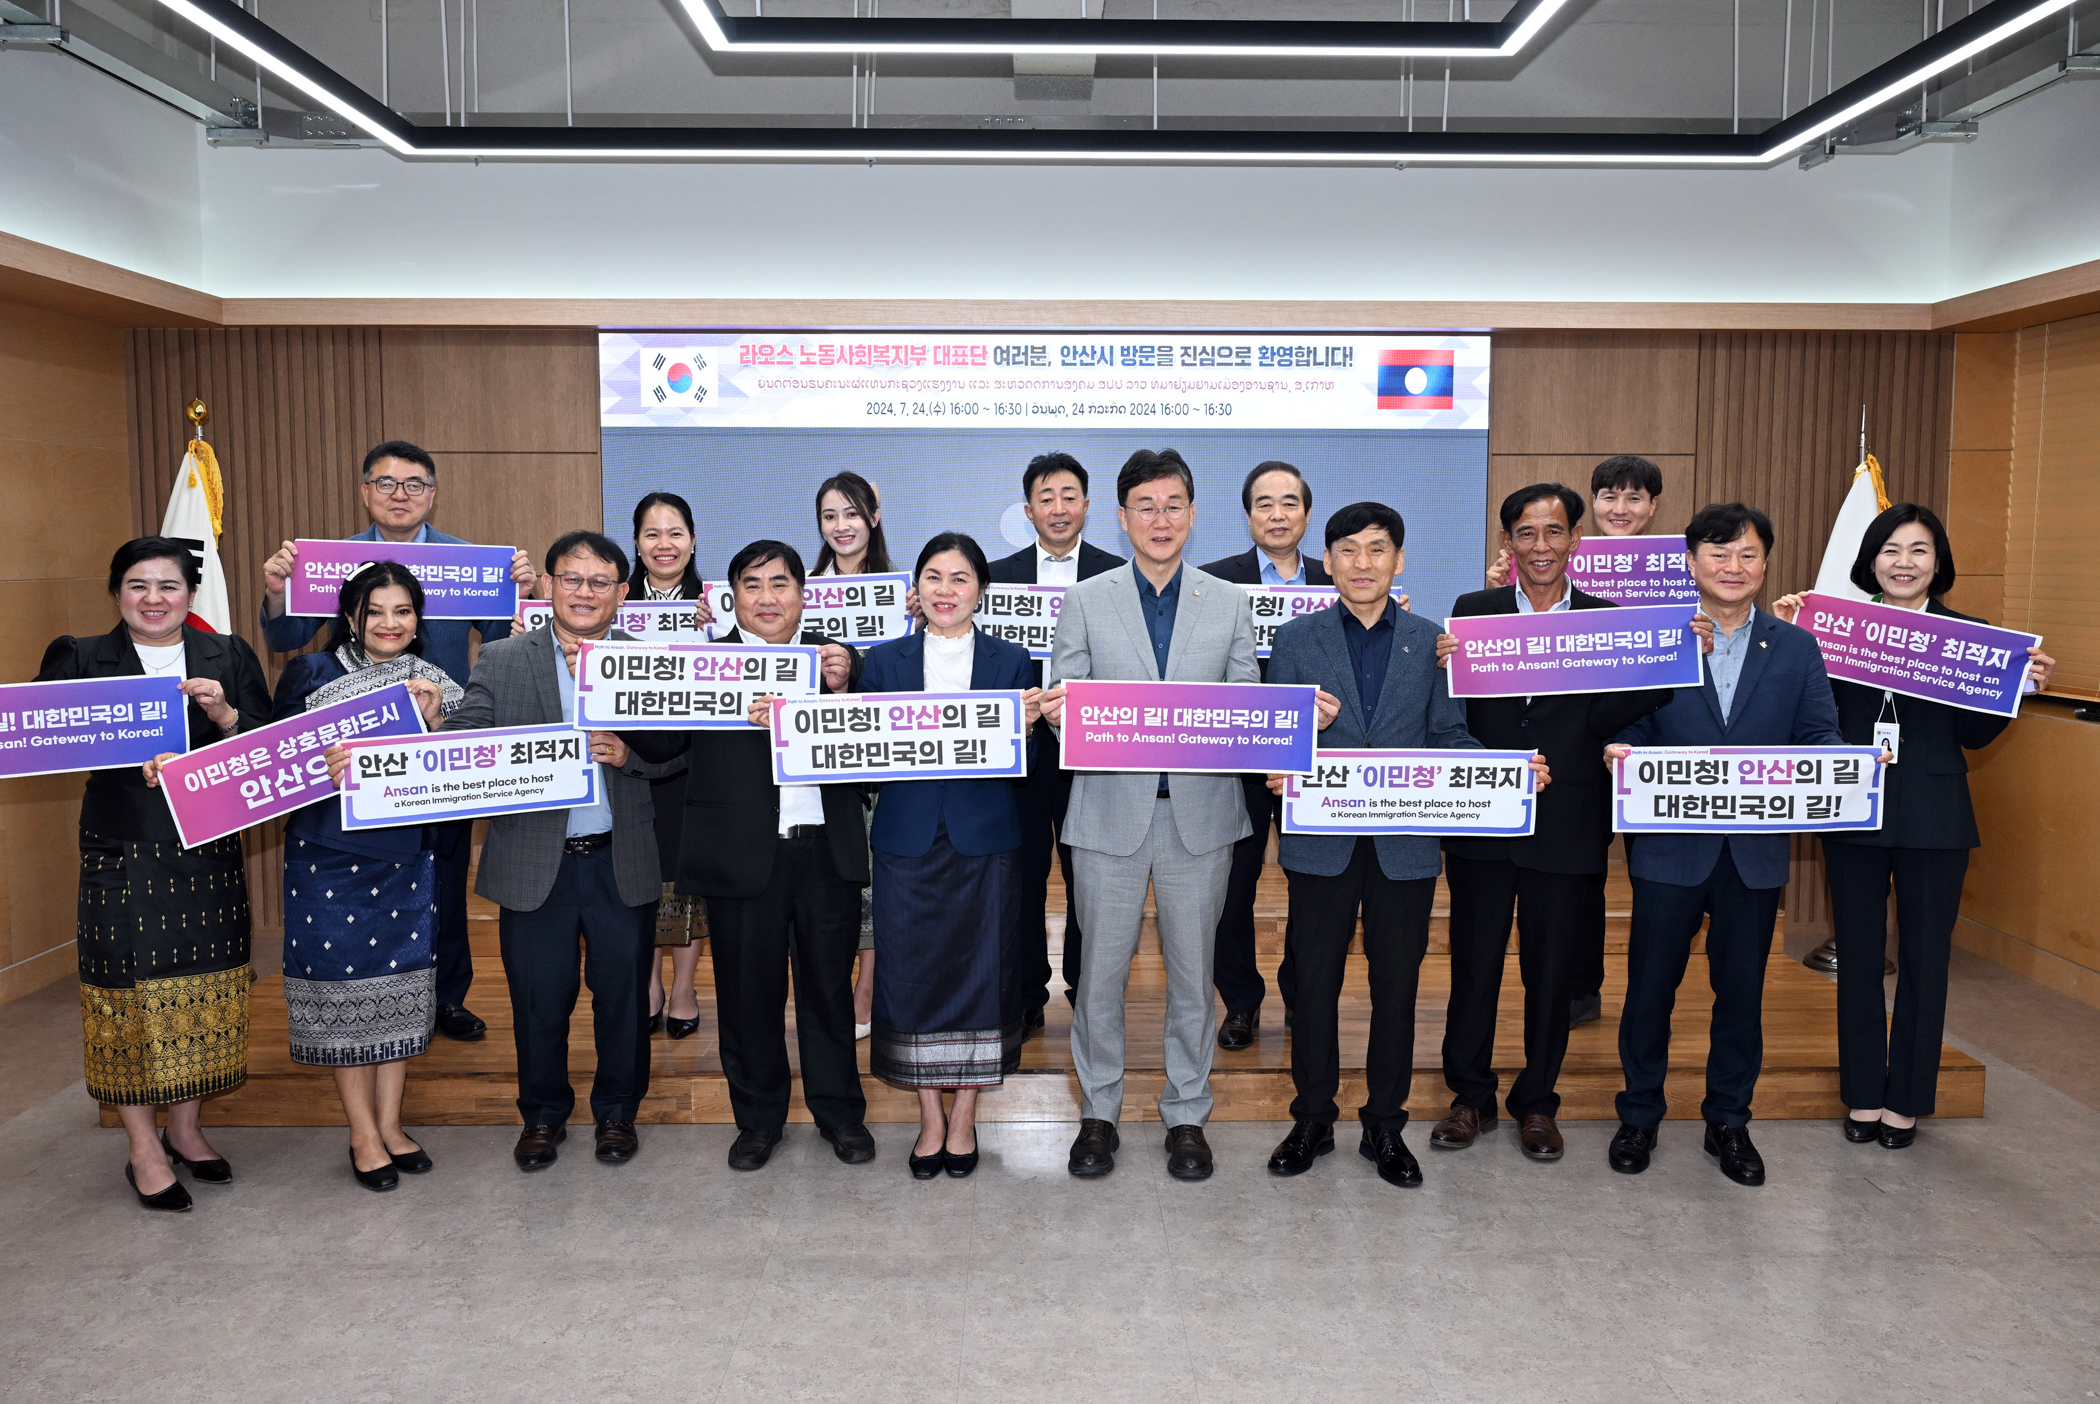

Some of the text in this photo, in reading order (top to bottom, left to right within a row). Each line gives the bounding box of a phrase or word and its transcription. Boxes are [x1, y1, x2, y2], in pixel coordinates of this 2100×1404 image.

[739, 344, 1354, 368] 라오스 노동사회복지부 대표단 여러분, 안산시 방문을 진심으로 환영합니다!
[1098, 379, 1122, 390] ສປປ
[1126, 380, 1147, 390] ລາວ
[866, 402, 897, 416] 2024.
[900, 402, 909, 416] 7.
[950, 402, 979, 416] 16:00
[994, 402, 1022, 416] 16:30
[1072, 402, 1084, 416] 24
[1130, 402, 1156, 416] 2024
[1160, 403, 1189, 416] 16:00
[1204, 403, 1232, 416] 16:30
[404, 564, 477, 583] 한민국의
[482, 567, 504, 583] 길!
[1646, 553, 1690, 572] 최적
[309, 584, 336, 594] Path
[450, 588, 460, 596] to
[463, 588, 499, 598] Korea!
[1592, 578, 1615, 587] best
[1618, 578, 1647, 589] place
[1650, 578, 1660, 587] to
[1663, 578, 1686, 586] host
[1625, 589, 1665, 598] Service
[873, 585, 895, 606] 길
[855, 616, 884, 637] 길!
[981, 624, 1055, 647] 대한민
[1464, 629, 1682, 658] 안산의 길! 대한민국의 길!
[1813, 611, 2012, 670] 안산 ‘이민청’ 최적지
[600, 655, 798, 682] 이민청! 안산의 길
[1471, 651, 1678, 673] Path to Ansan! Gateway to Korea!
[1849, 644, 1858, 655] is
[1860, 645, 1878, 659] the
[1880, 649, 1906, 665] best
[1907, 654, 1939, 673] place
[1941, 663, 1953, 675] to
[1955, 666, 1981, 683] host
[1983, 675, 2000, 685] an
[1844, 654, 1911, 678] Immigration
[1912, 672, 1955, 690] Service
[1956, 680, 2003, 700] Agency
[614, 691, 742, 716] 대한민국의
[22, 703, 134, 730] 대한민국의
[140, 701, 168, 721] 길!
[794, 703, 1000, 734] 이민청! 안산의 길
[1080, 706, 1299, 729] 안산의 길! 대한민국의 길!
[31, 732, 96, 747] Gateway
[100, 731, 115, 741] to
[118, 726, 164, 740] Korea!
[184, 702, 400, 792] 이민청은 상호문화도시
[1085, 731, 1293, 747] Path to Ansan! Gateway to Korea!
[358, 737, 580, 779] 안산 ‘이민청’ 최적지
[811, 739, 987, 769] 대한민국의 길!
[1356, 765, 1443, 789] ‘이민청’
[1449, 766, 1522, 789] 최적지
[1638, 759, 1859, 785] 이민청! 안산의 길
[383, 773, 554, 798] Ansan is the best place to host
[401, 797, 431, 807] Korean
[432, 793, 482, 807] Immigration
[483, 790, 514, 800] Service
[514, 787, 545, 798] Agency
[1321, 796, 1492, 810] Ansan is the best place to host
[1654, 794, 1842, 820] 대한민국의 길!
[1368, 810, 1416, 820] Immigration
[1418, 811, 1449, 819] Service
[1450, 811, 1480, 820] Agency
